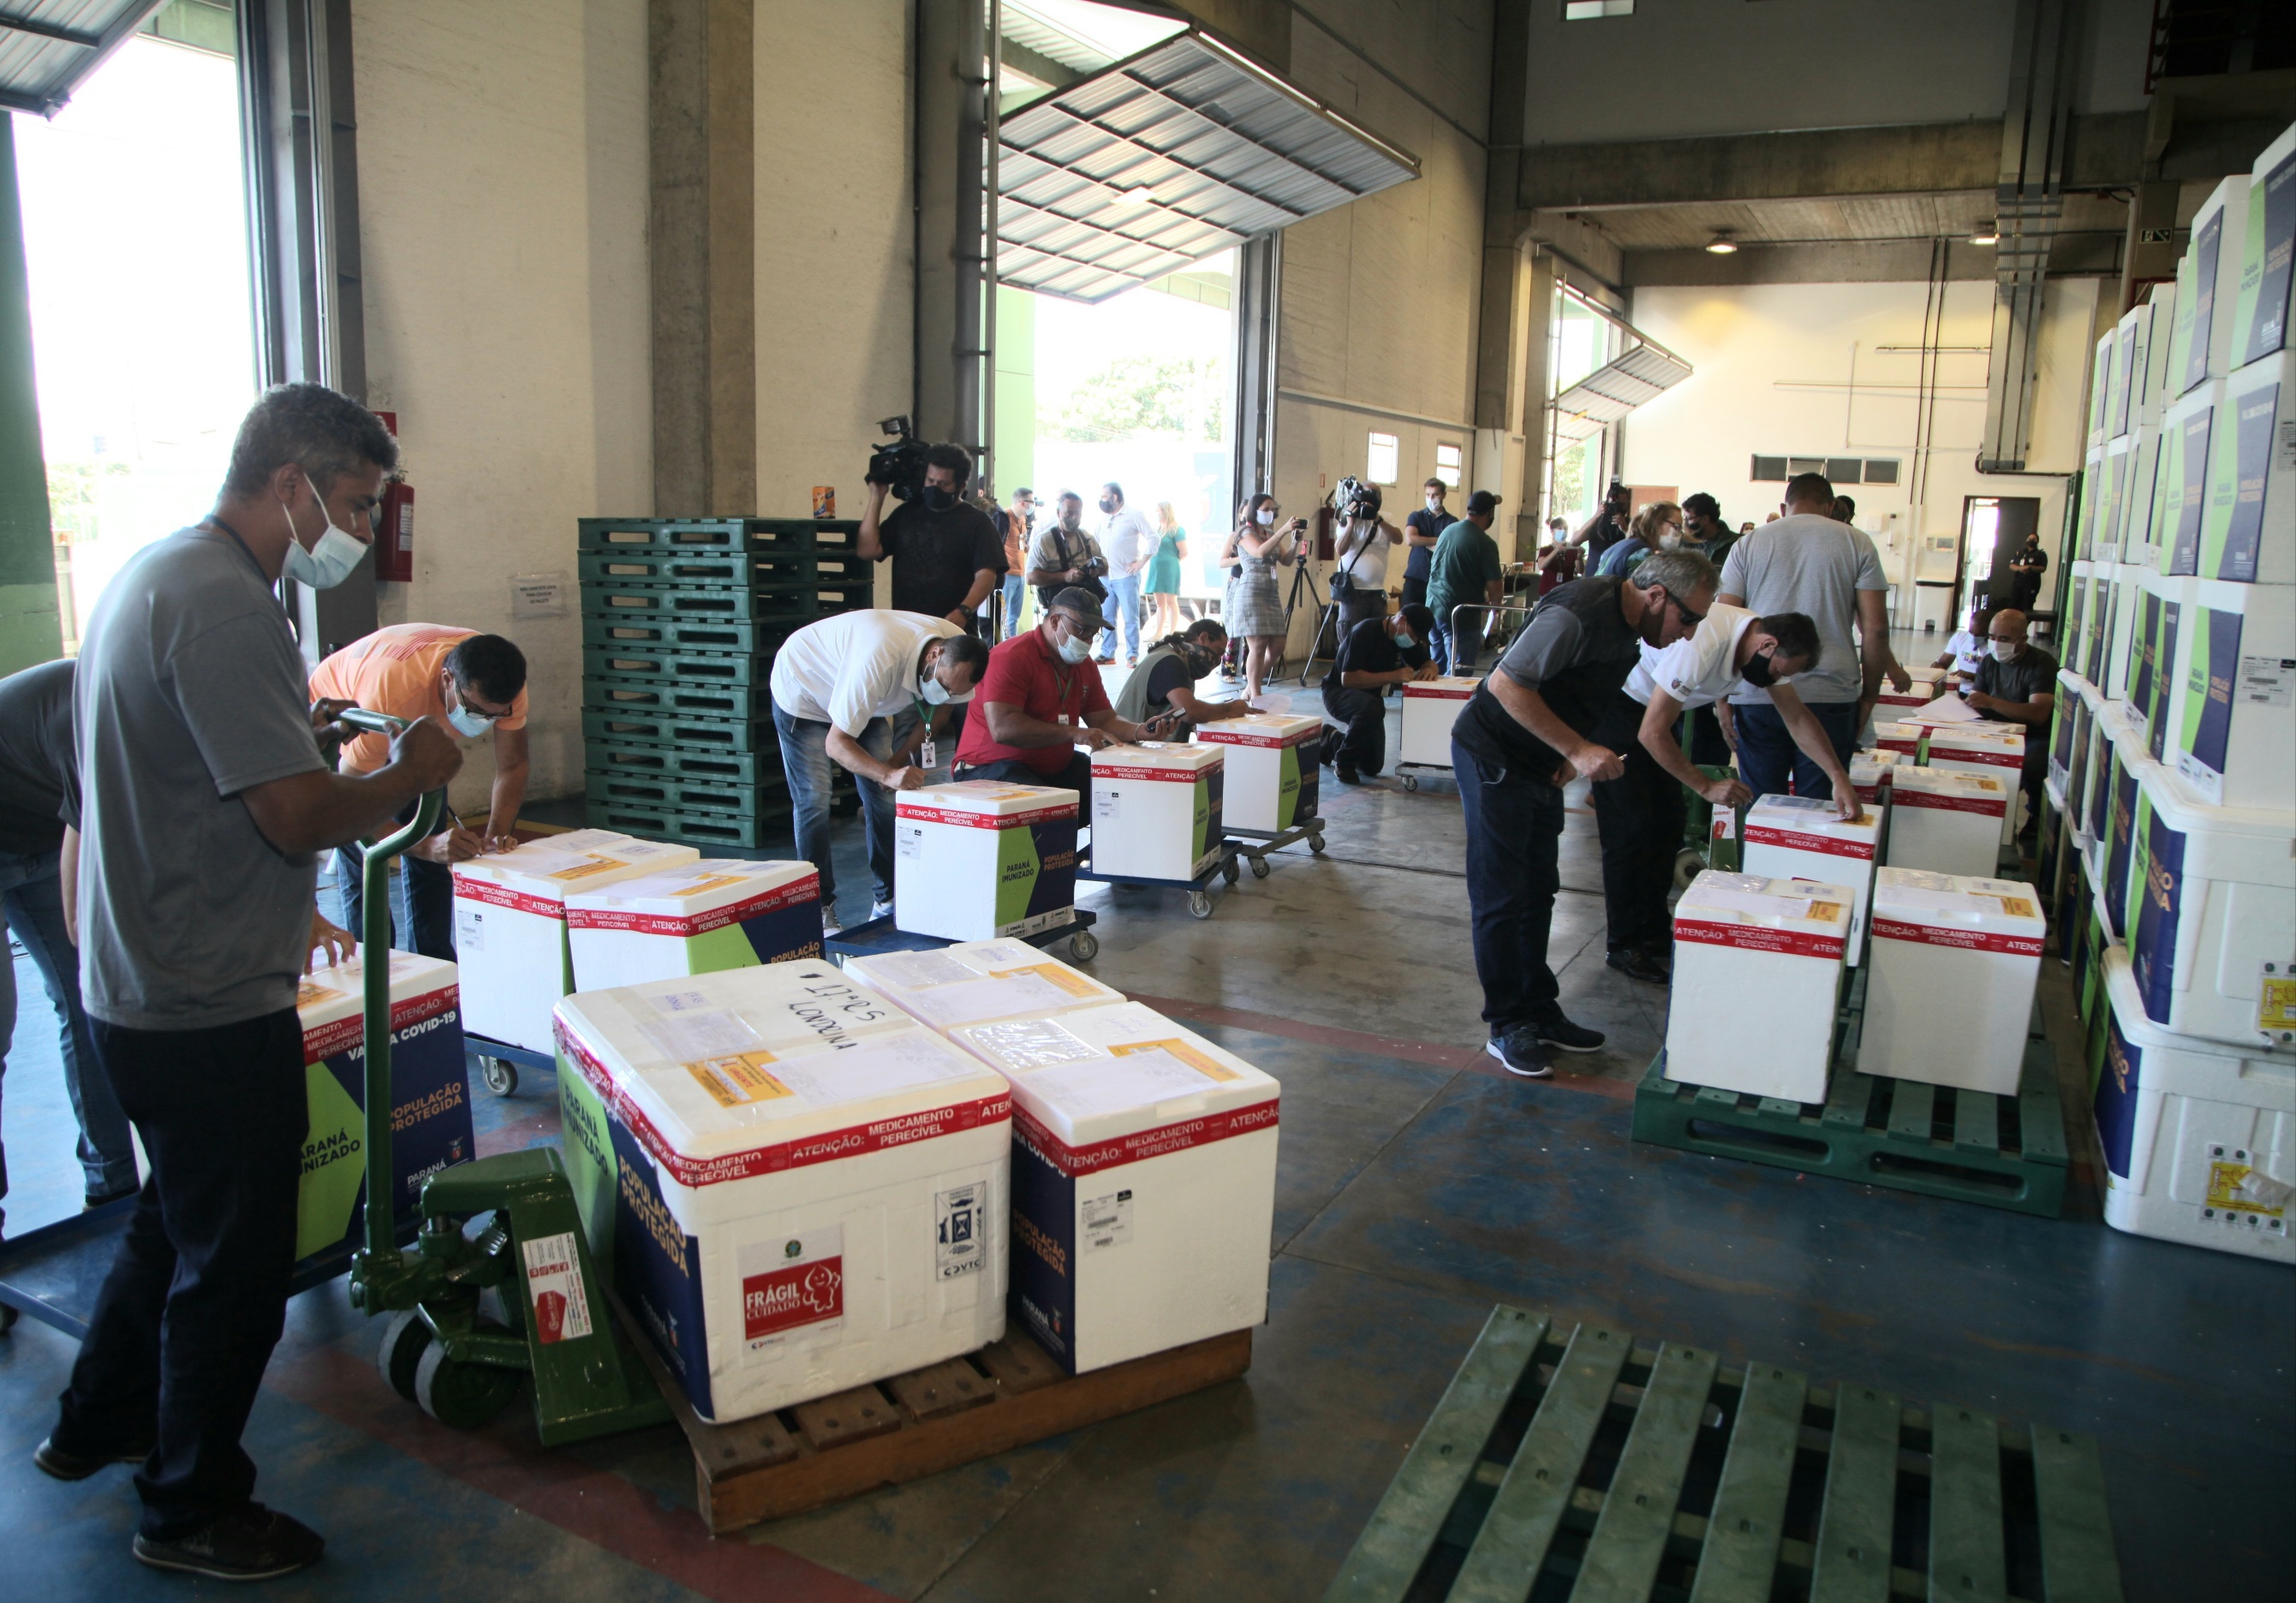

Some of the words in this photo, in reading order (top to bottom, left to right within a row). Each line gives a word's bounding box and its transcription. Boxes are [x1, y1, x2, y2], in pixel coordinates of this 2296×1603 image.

[907, 807, 939, 819] ATENÇÃO:
[939, 810, 980, 820] MEDICAMENTO
[945, 817, 975, 826] PERECÍVEL
[1002, 868, 1035, 883] IMUNIZADO
[1006, 859, 1030, 873] PARANÁ
[1044, 858, 1074, 872] PROTEGIDA
[477, 885, 519, 900] MEDICAMENTO
[482, 893, 515, 907] PERECÍVEL
[591, 912, 636, 922] MEDICAMENTO
[651, 919, 691, 933] ATENÇÃO:
[692, 905, 736, 924] MEDICAMENTO
[781, 879, 820, 897] MEDICAMENTO
[698, 916, 731, 932] PERECÍVEL
[1921, 927, 1987, 941] MEDICAMENTO
[1727, 929, 1792, 943] MEDICAMENTO
[771, 941, 820, 964] POPULAÇÃO
[395, 998, 443, 1024] ATENÇÃO:
[400, 1010, 457, 1041] COVID-19
[792, 1133, 865, 1159] ATENÇÃO:
[868, 1108, 954, 1136] MEDICAMENTO
[880, 1123, 944, 1147] PERECÍVEL
[1062, 1147, 1123, 1169] ATENÇÃO:
[1125, 1120, 1205, 1149] MEDICAMENTO
[302, 1139, 361, 1174] NIZADO
[1136, 1135, 1196, 1158] PERECÍVEL
[407, 1158, 447, 1185] PARANÁ
[621, 1178, 690, 1278] PROTEGIDA
[746, 1282, 800, 1310] FRÁGIL
[746, 1298, 801, 1320] CUIDADO
